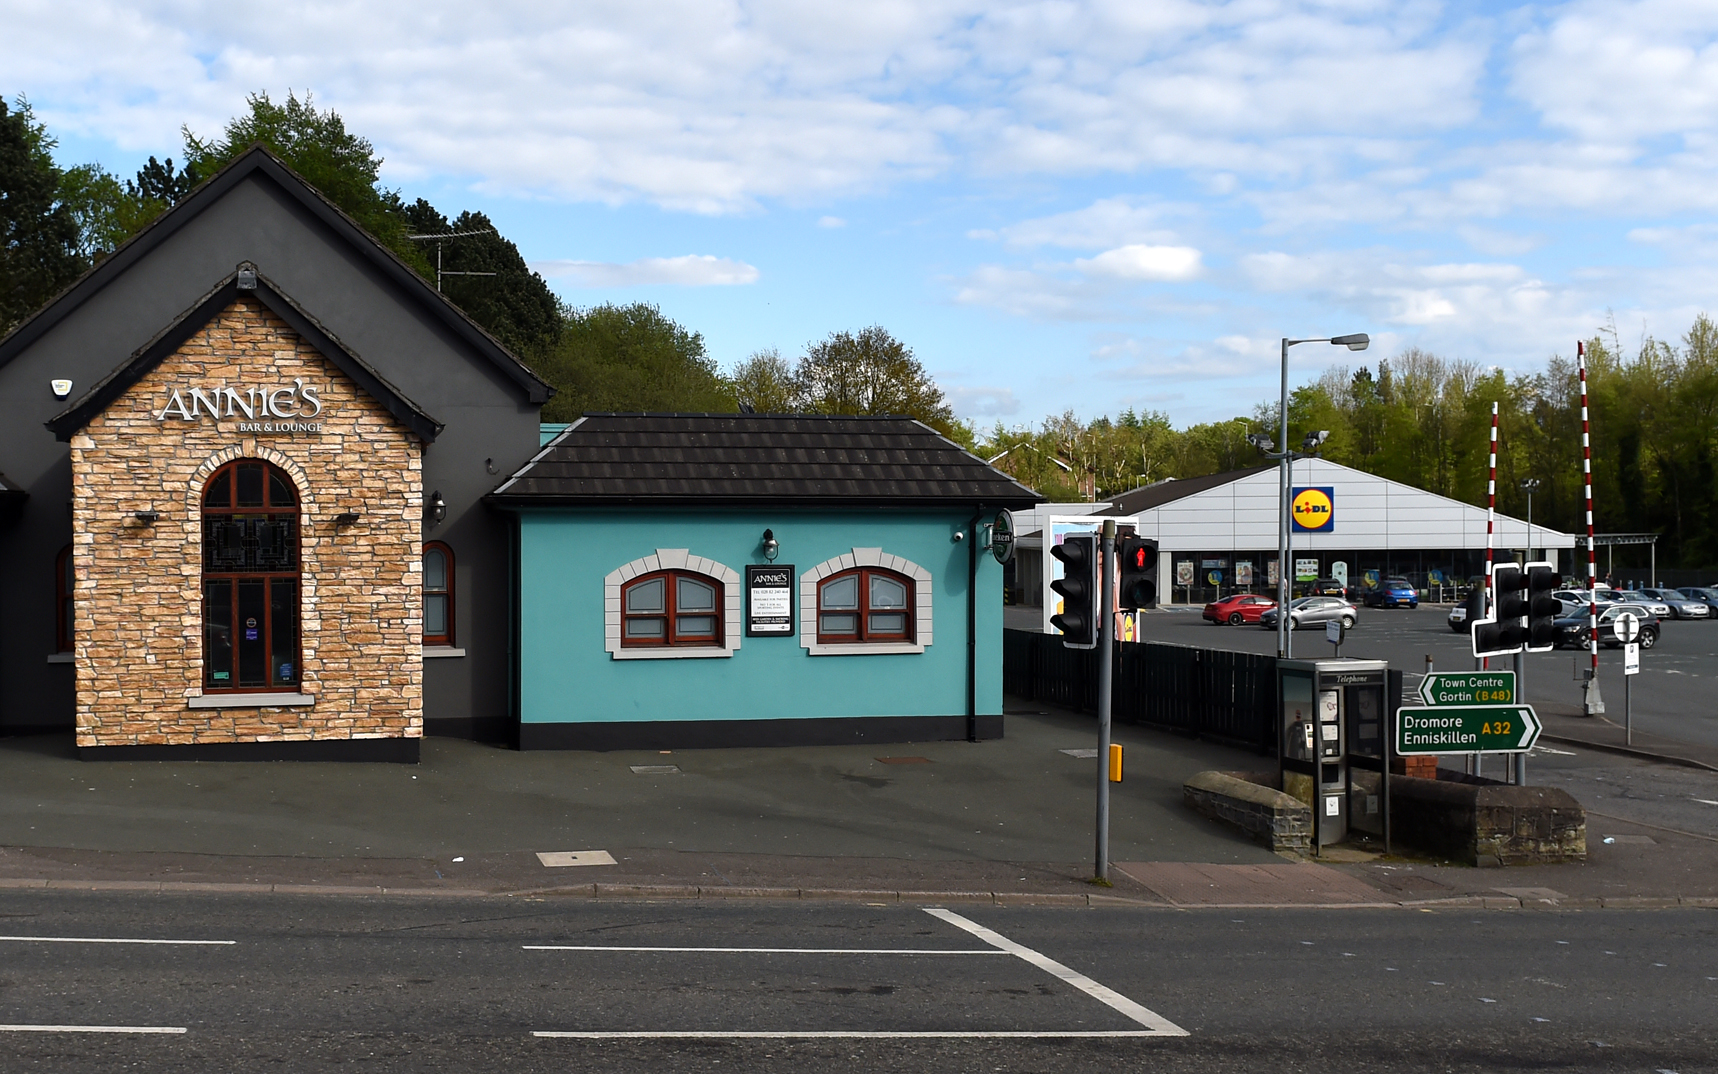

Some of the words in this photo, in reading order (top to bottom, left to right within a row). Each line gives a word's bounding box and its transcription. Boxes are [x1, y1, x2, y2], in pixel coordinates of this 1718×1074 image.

[156, 377, 322, 420] ANNIE'S
[240, 423, 264, 432] BAR
[264, 423, 274, 432] &
[275, 423, 322, 432] LOUNGE
[754, 573, 787, 583] ANNIE'S
[1336, 674, 1368, 684] Telephone
[1439, 677, 1466, 688] Town
[1469, 676, 1504, 688] Centre
[1439, 691, 1472, 702] Gortin
[1404, 715, 1463, 728] Dromore
[1404, 731, 1477, 745] Enniskillen
